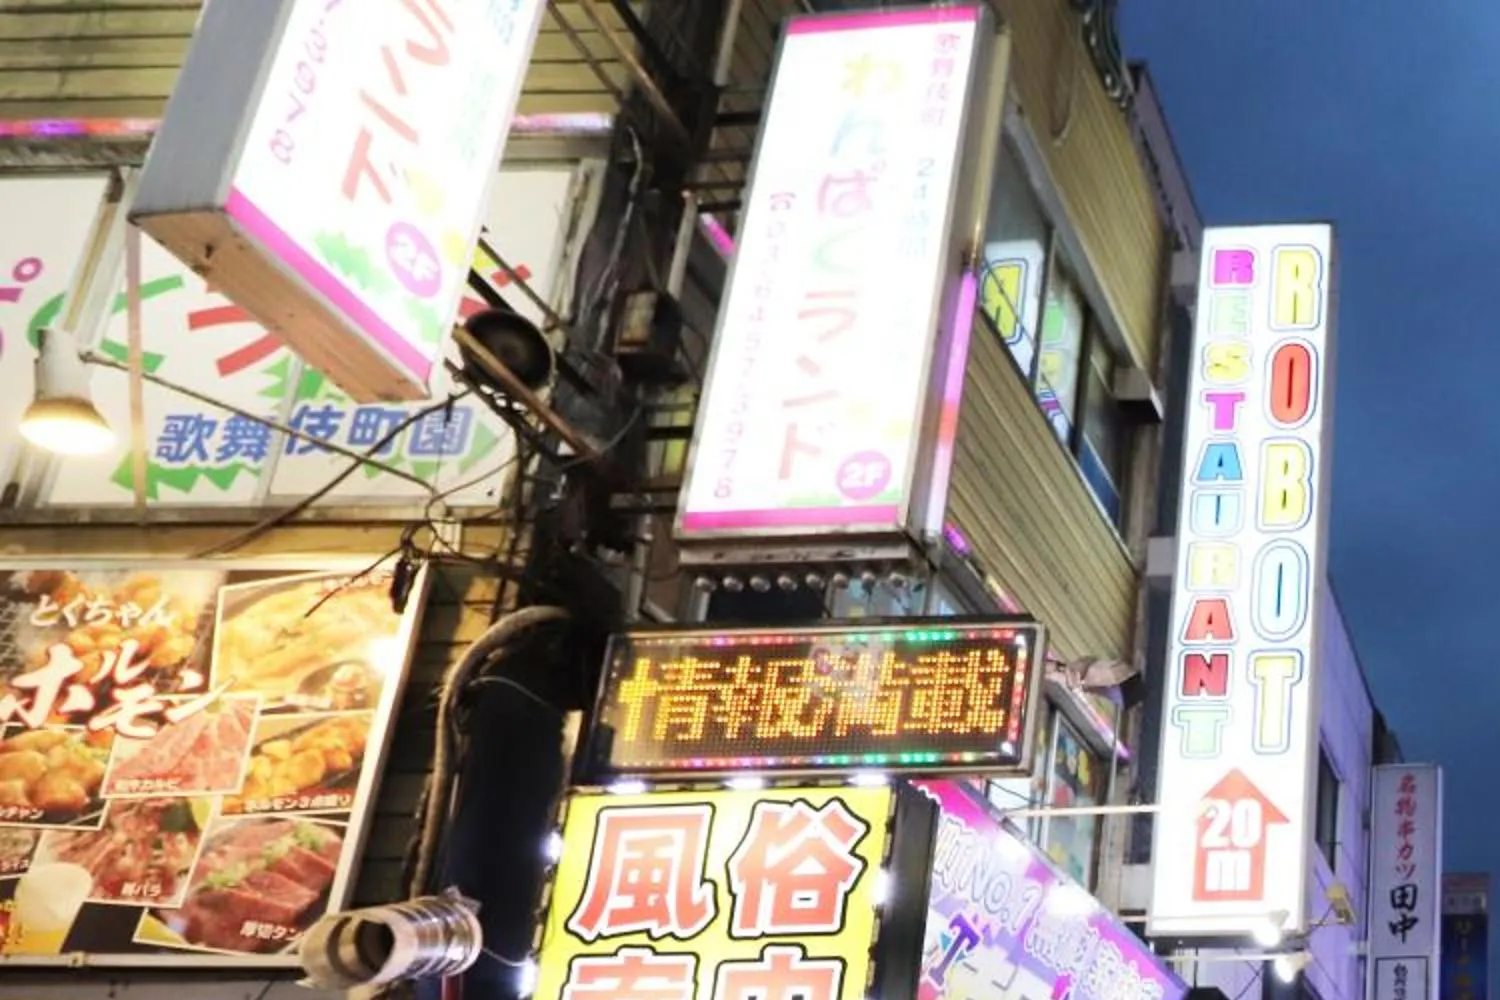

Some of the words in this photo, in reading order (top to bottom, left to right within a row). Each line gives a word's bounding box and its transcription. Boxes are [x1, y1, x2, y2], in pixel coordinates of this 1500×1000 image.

[156, 405, 473, 464] 歌舞伎町園
[842, 459, 885, 489] 2F
[1252, 245, 1321, 755] ROBOT
[1174, 246, 1258, 758] RESTAURANT
[29, 596, 176, 629] とくちゃん
[1200, 797, 1263, 848] 20
[568, 799, 870, 941] 風俗
[1204, 848, 1253, 893] m
